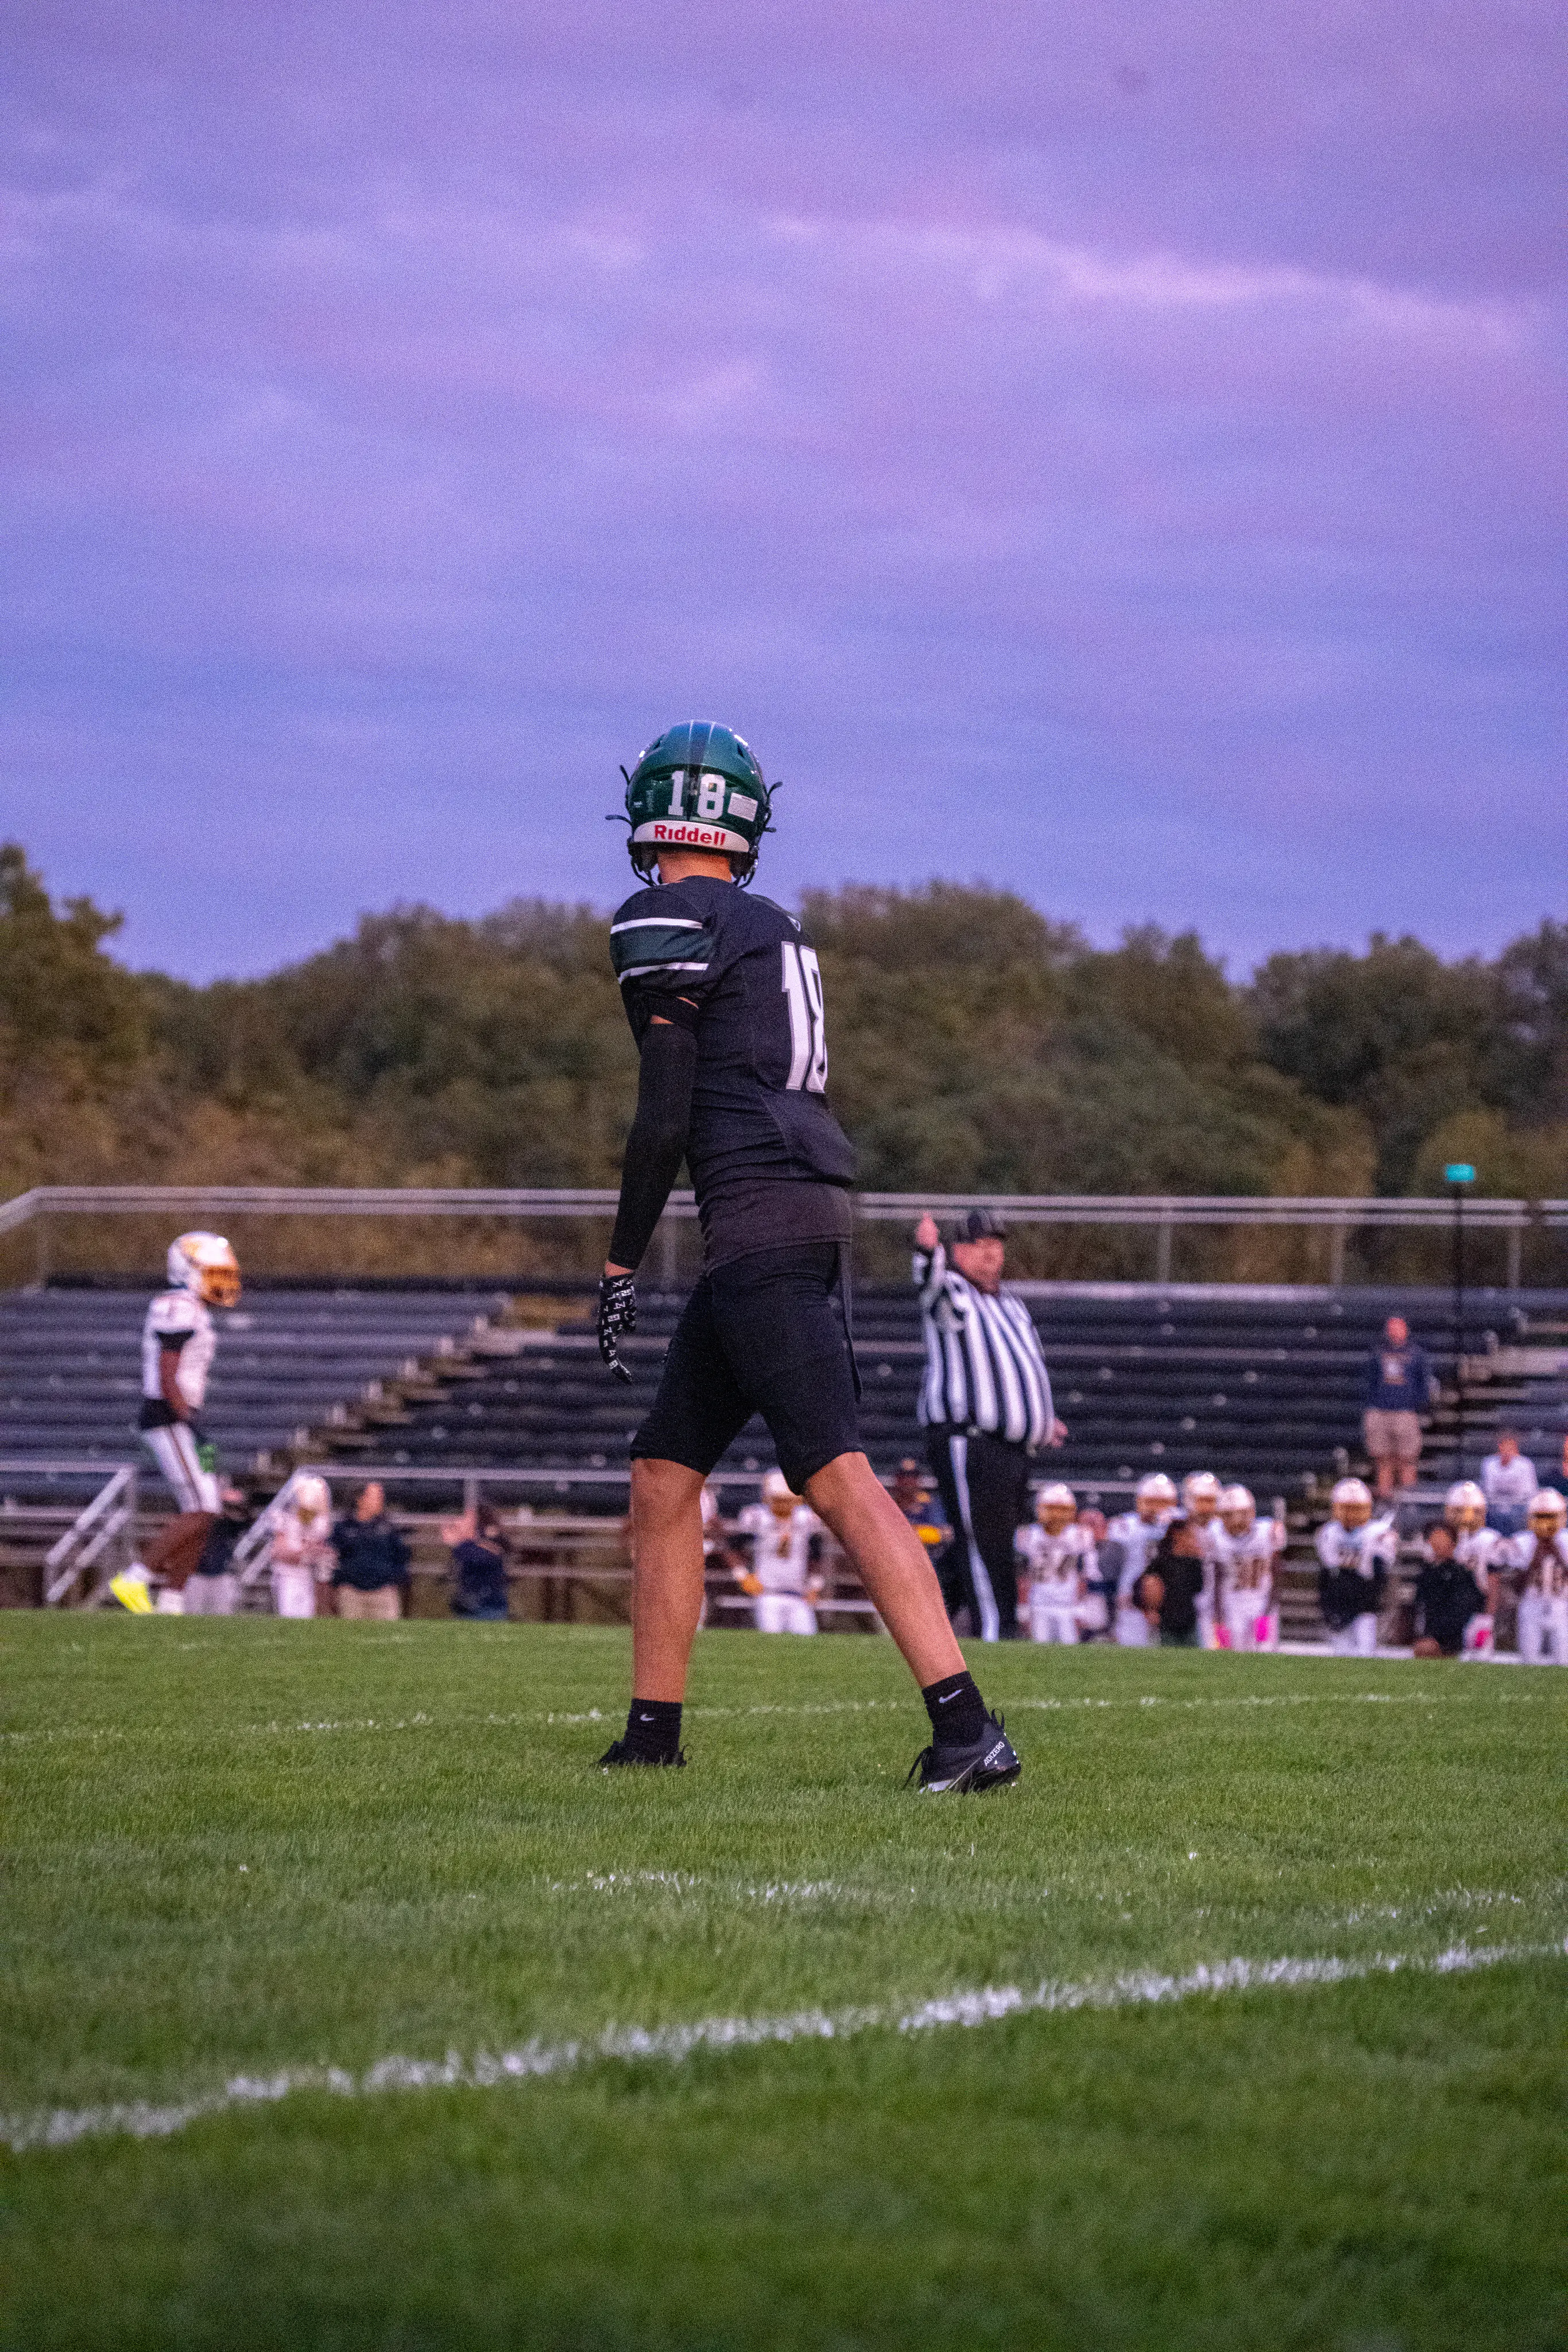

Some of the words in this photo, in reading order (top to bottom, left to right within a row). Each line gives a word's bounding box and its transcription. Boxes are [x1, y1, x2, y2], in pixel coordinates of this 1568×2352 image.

[668, 770, 726, 819] 18
[655, 825, 726, 846] Riddell
[984, 1740, 1005, 1767] ADIZERO
